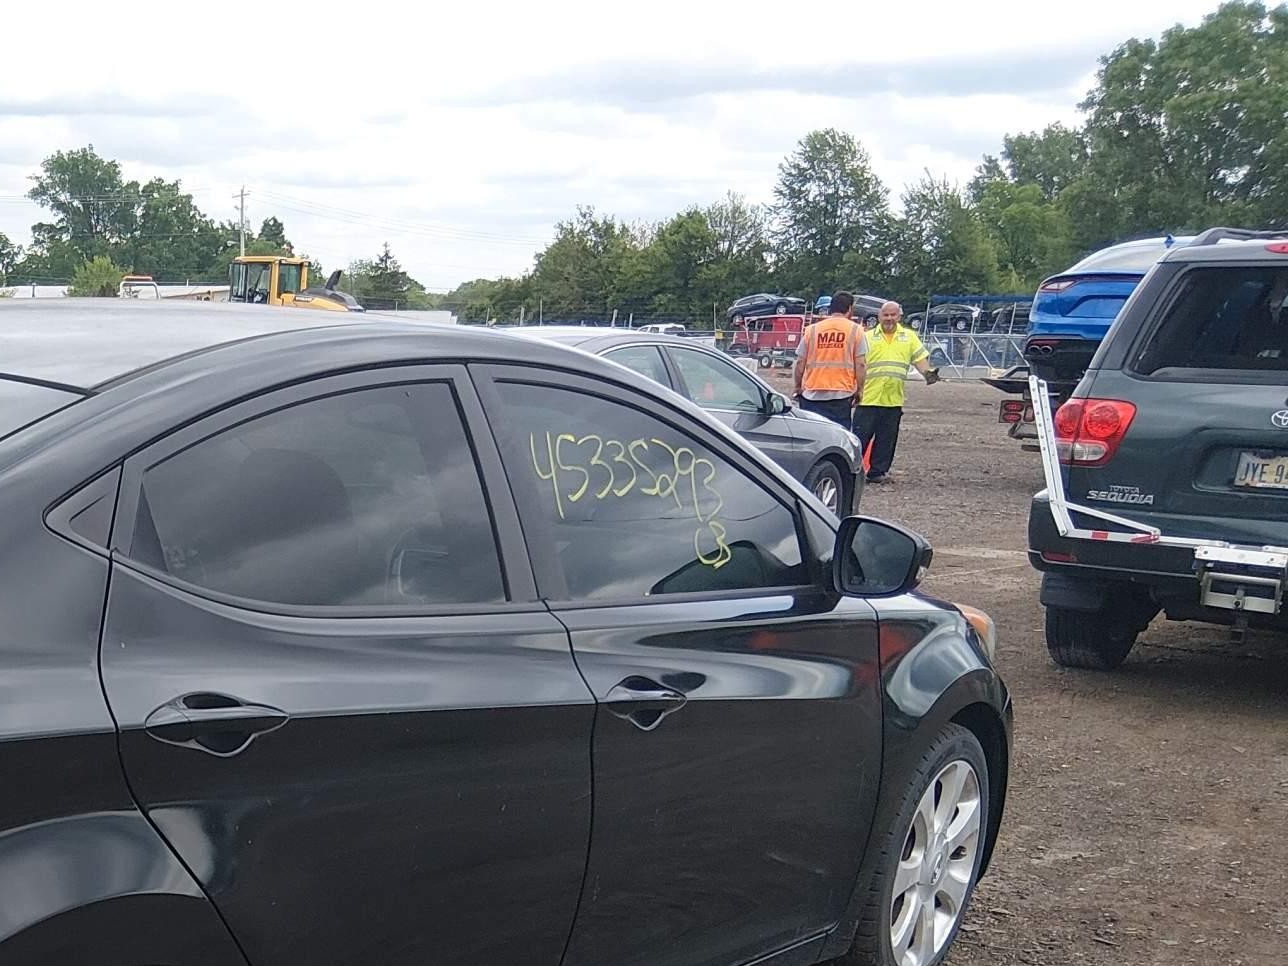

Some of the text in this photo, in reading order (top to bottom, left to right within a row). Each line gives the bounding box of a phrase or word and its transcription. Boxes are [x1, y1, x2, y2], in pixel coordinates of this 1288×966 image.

[817, 331, 846, 344] MAD
[530, 431, 723, 522] 45335293
[1238, 462, 1270, 483] JYE
[1086, 490, 1154, 505] SEQUOIA
